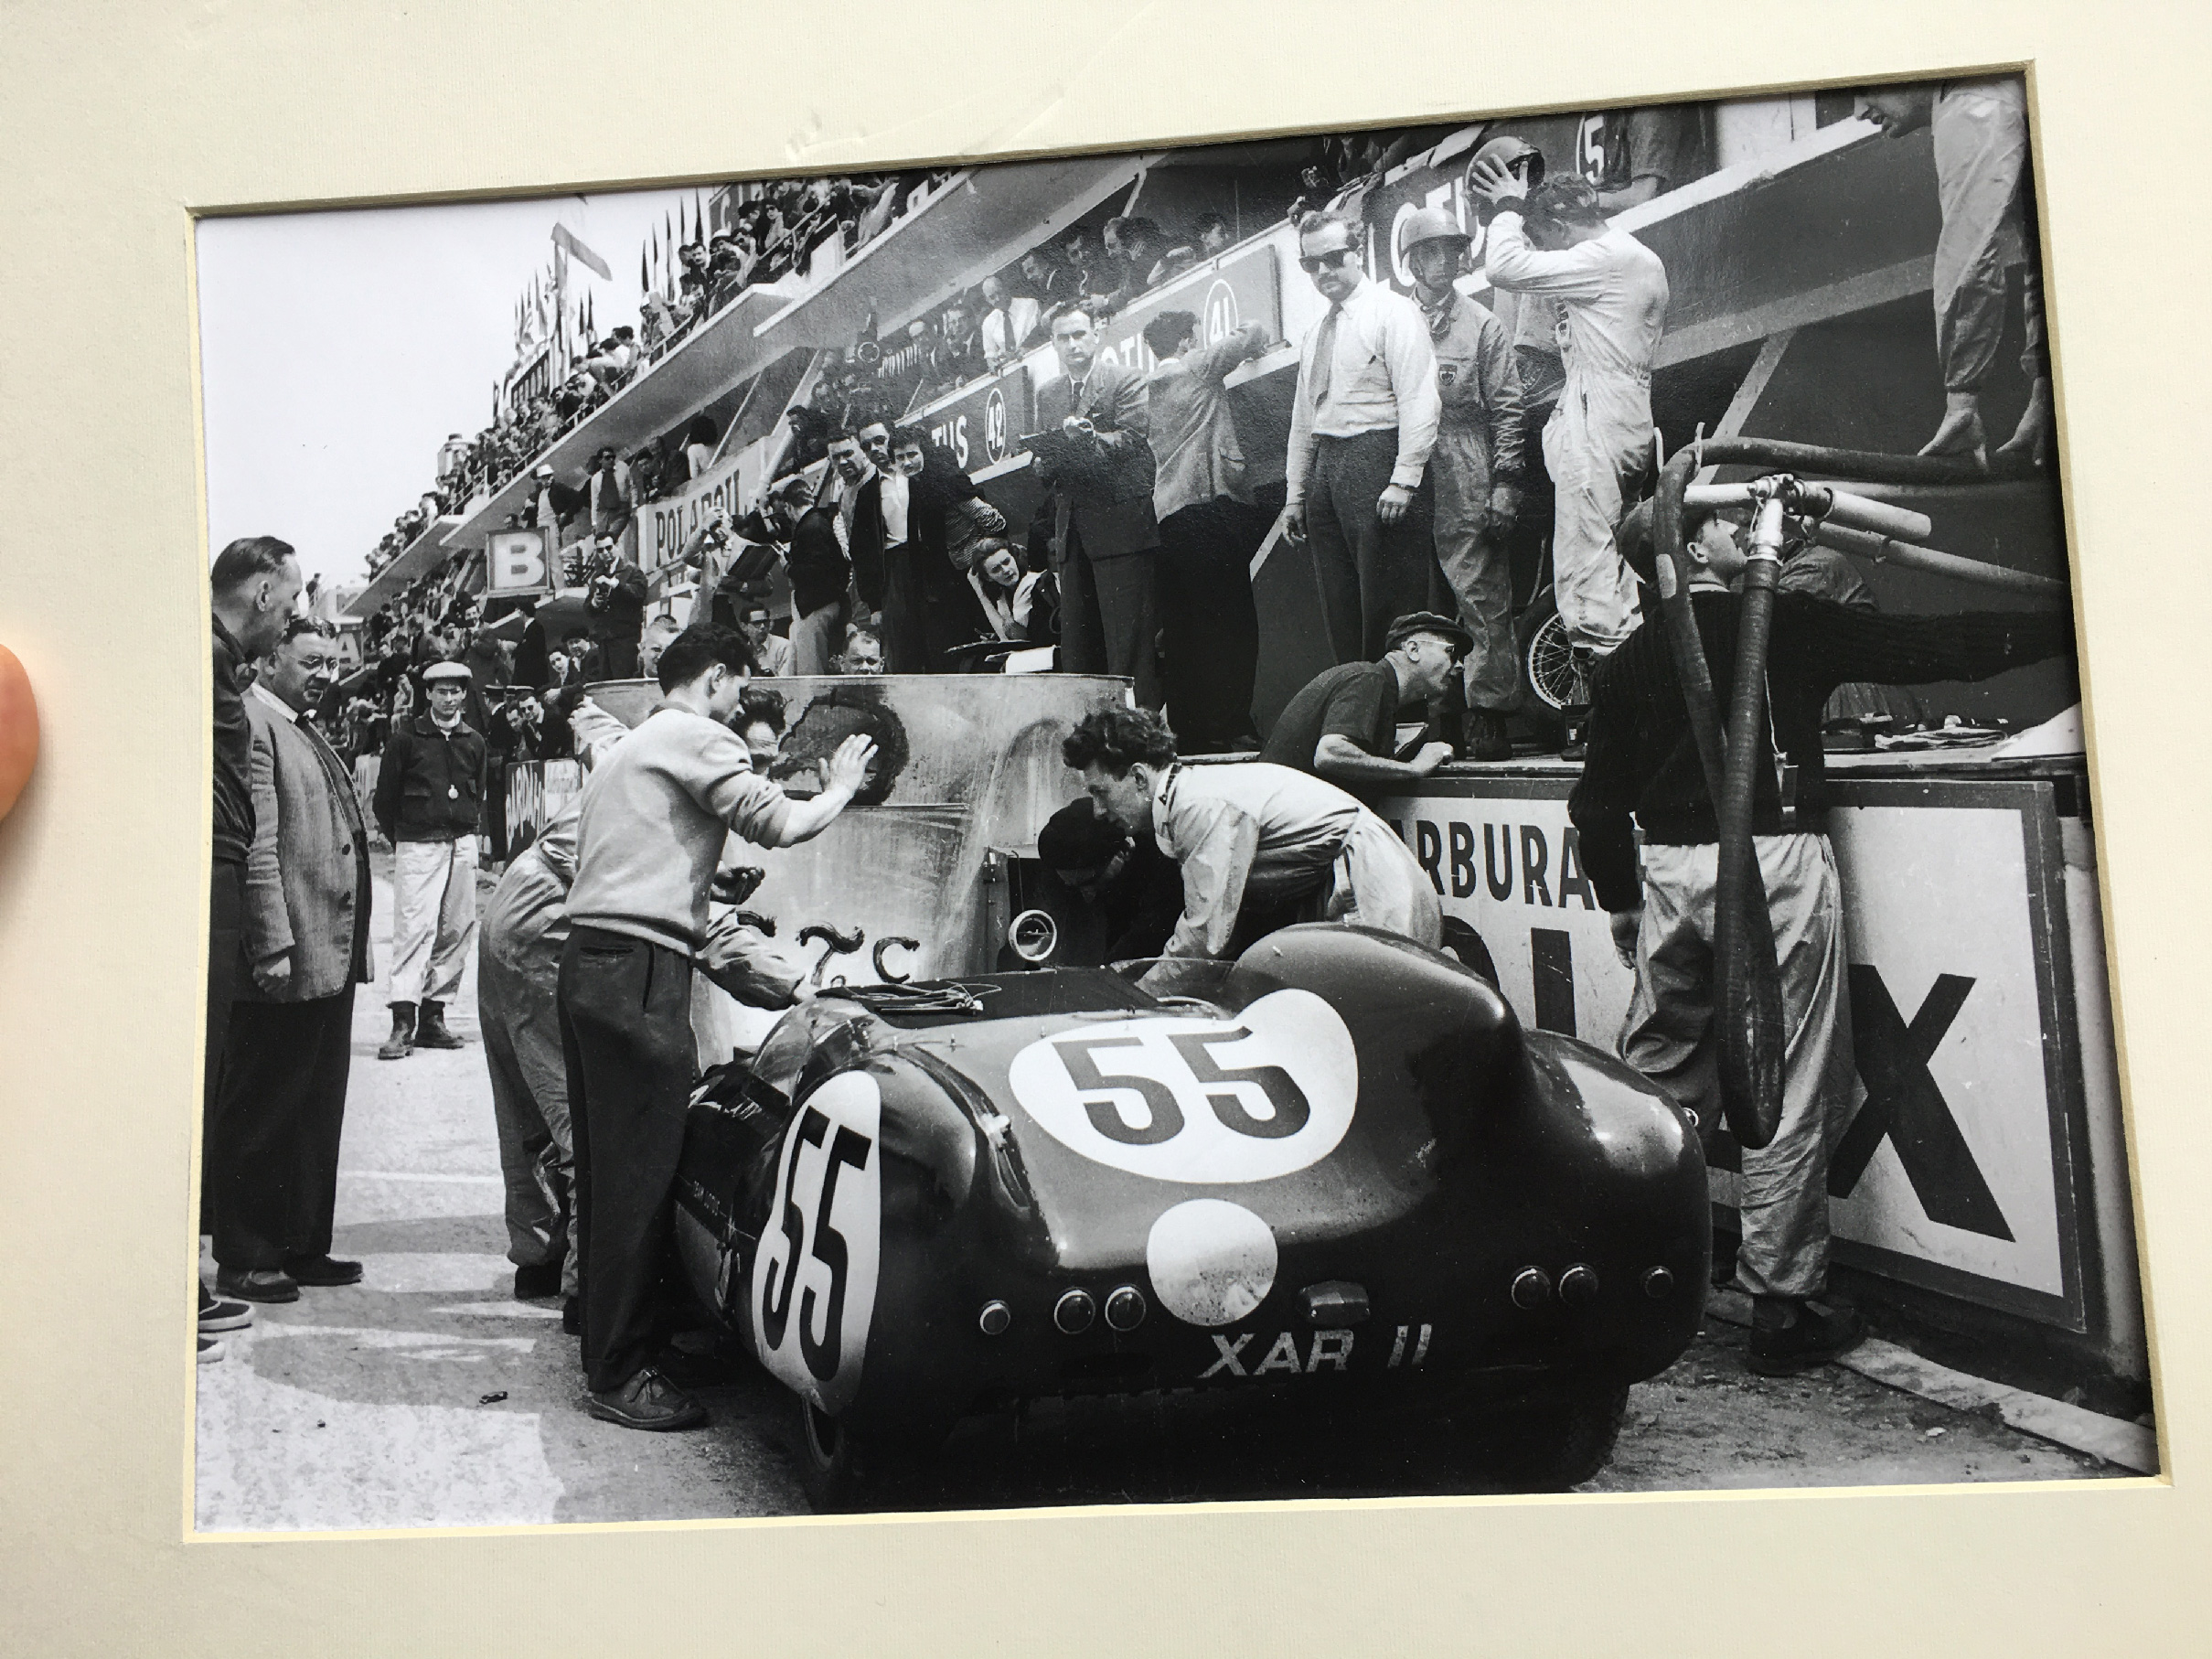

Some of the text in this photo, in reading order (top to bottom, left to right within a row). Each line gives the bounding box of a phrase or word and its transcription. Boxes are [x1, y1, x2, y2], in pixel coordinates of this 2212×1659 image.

[1209, 297, 1232, 347] 41
[988, 401, 1004, 450] 42
[494, 532, 545, 588] B
[1390, 819, 1597, 911] RBURA
[1052, 1025, 1311, 1145] 55
[763, 1105, 871, 1382] 55
[1196, 1329, 1354, 1378] XAR
